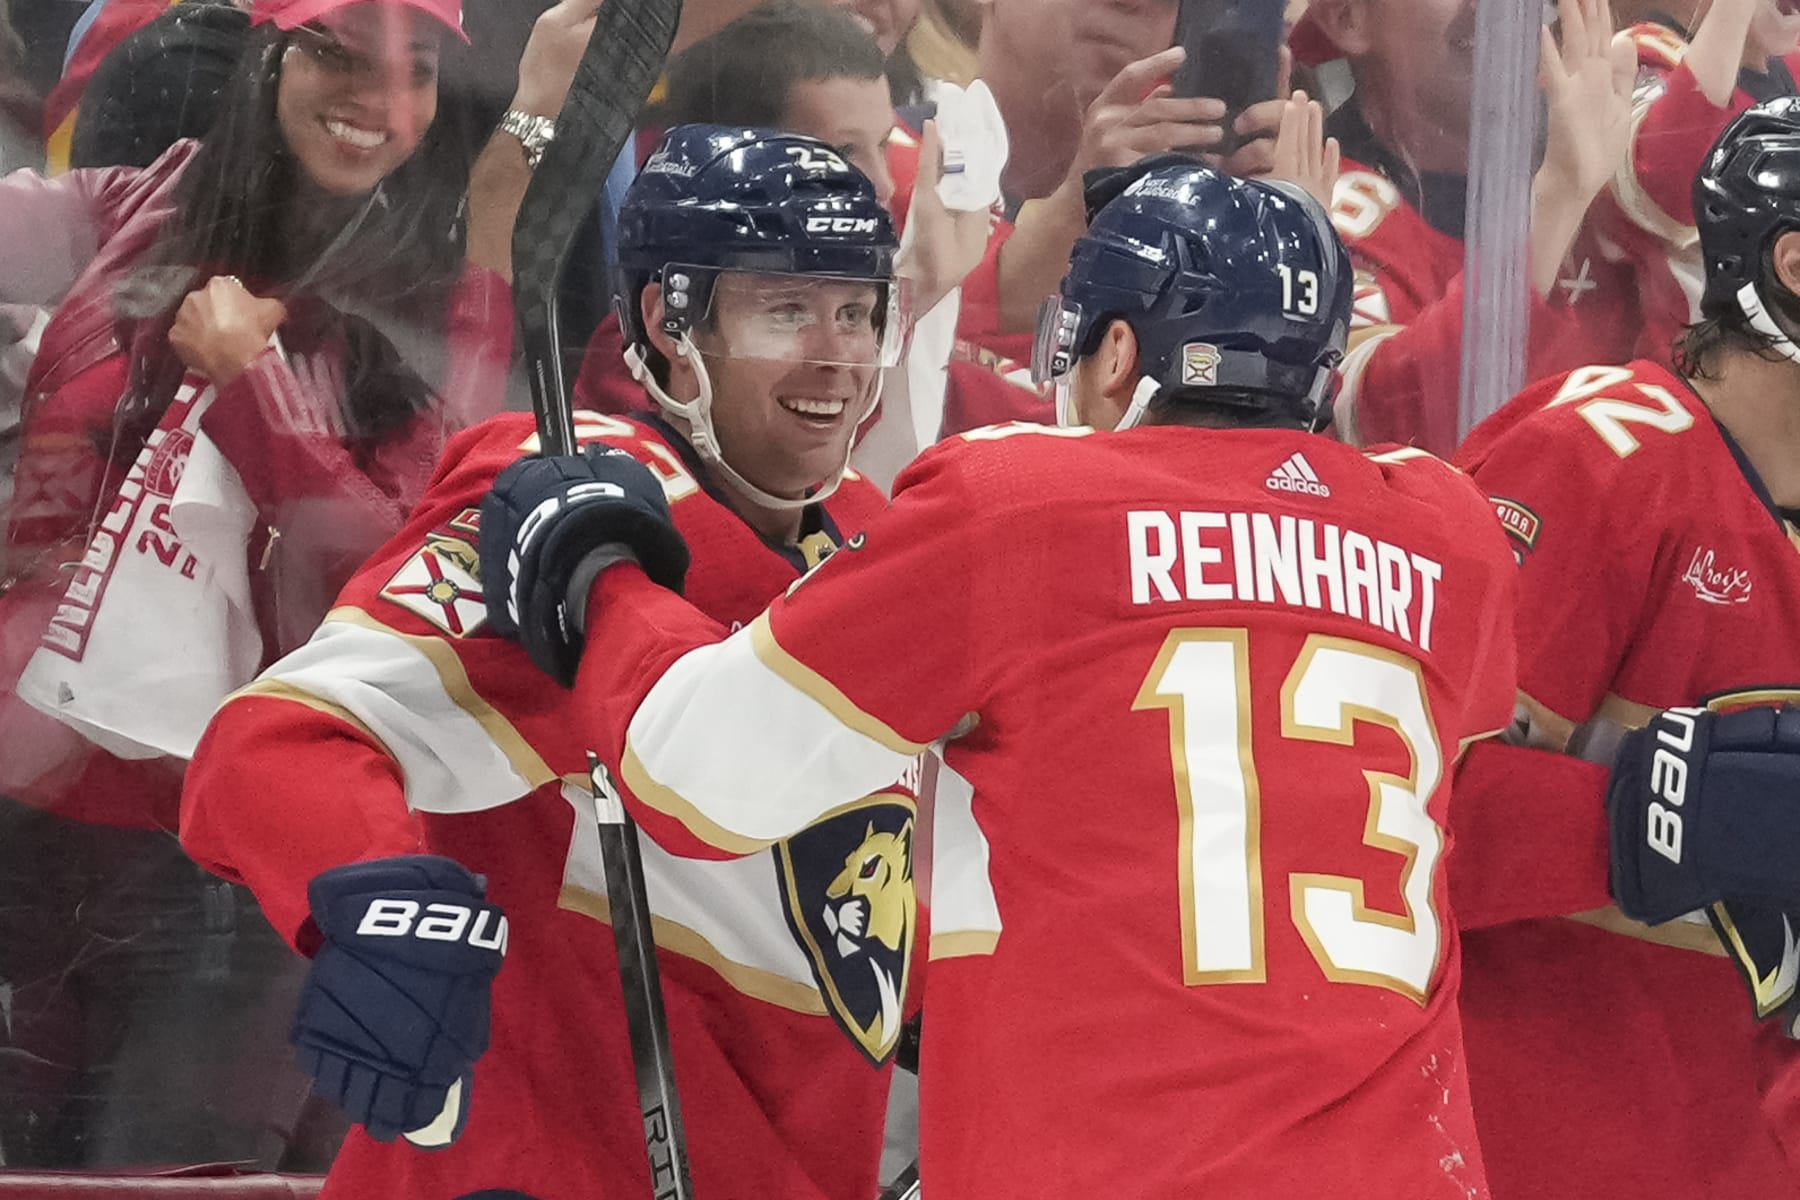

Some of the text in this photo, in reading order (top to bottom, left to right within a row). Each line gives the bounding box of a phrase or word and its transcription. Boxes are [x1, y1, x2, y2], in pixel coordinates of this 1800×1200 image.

[785, 147, 849, 173] 23
[806, 216, 874, 233] CCM
[1276, 263, 1318, 315] 13
[1496, 505, 1529, 533] RIDA
[1127, 510, 1442, 652] REINHART
[1682, 545, 1752, 604] LaCroix
[1647, 706, 1708, 864] Bau
[1130, 626, 1446, 1009] 13
[356, 898, 509, 958] Bau
